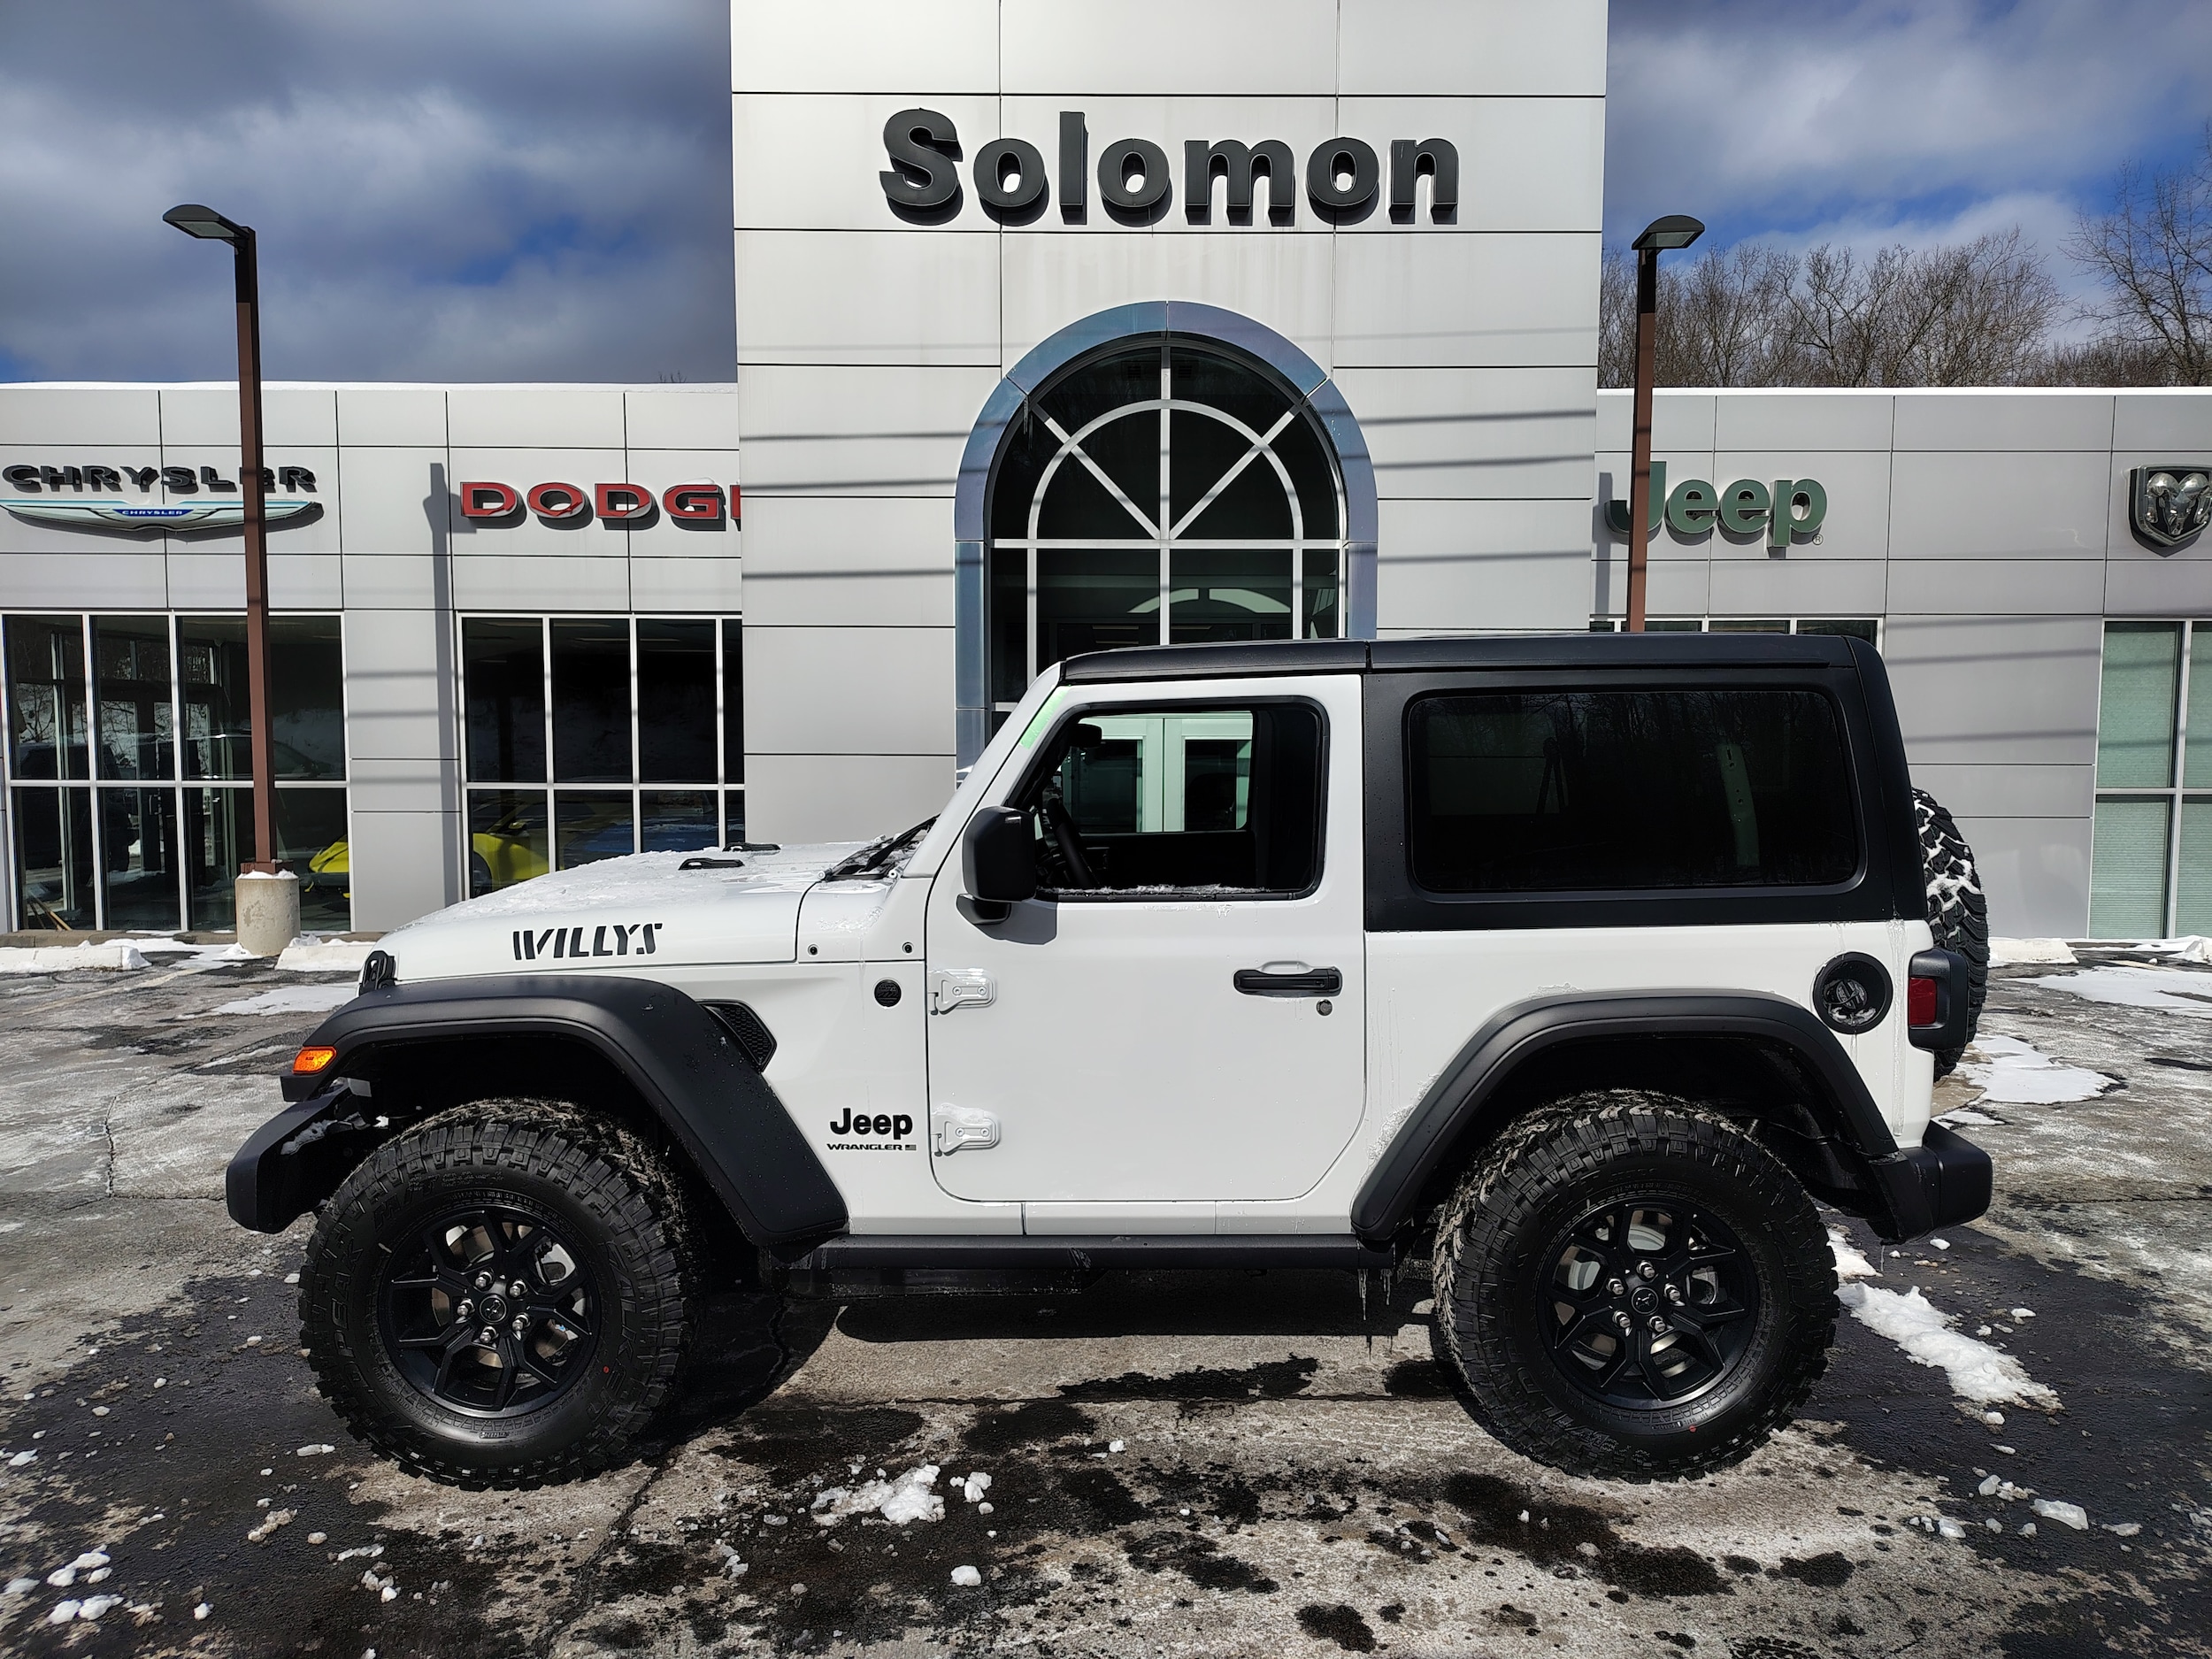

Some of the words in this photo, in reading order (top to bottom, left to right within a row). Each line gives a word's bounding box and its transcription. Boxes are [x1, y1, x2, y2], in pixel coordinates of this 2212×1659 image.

[879, 107, 1460, 219] Solomon
[2, 465, 317, 492] CHRYSLR
[460, 481, 741, 524] DODG
[1605, 461, 1827, 546] Jeep
[513, 923, 663, 961] WILLYS
[830, 1108, 913, 1140] Jeep
